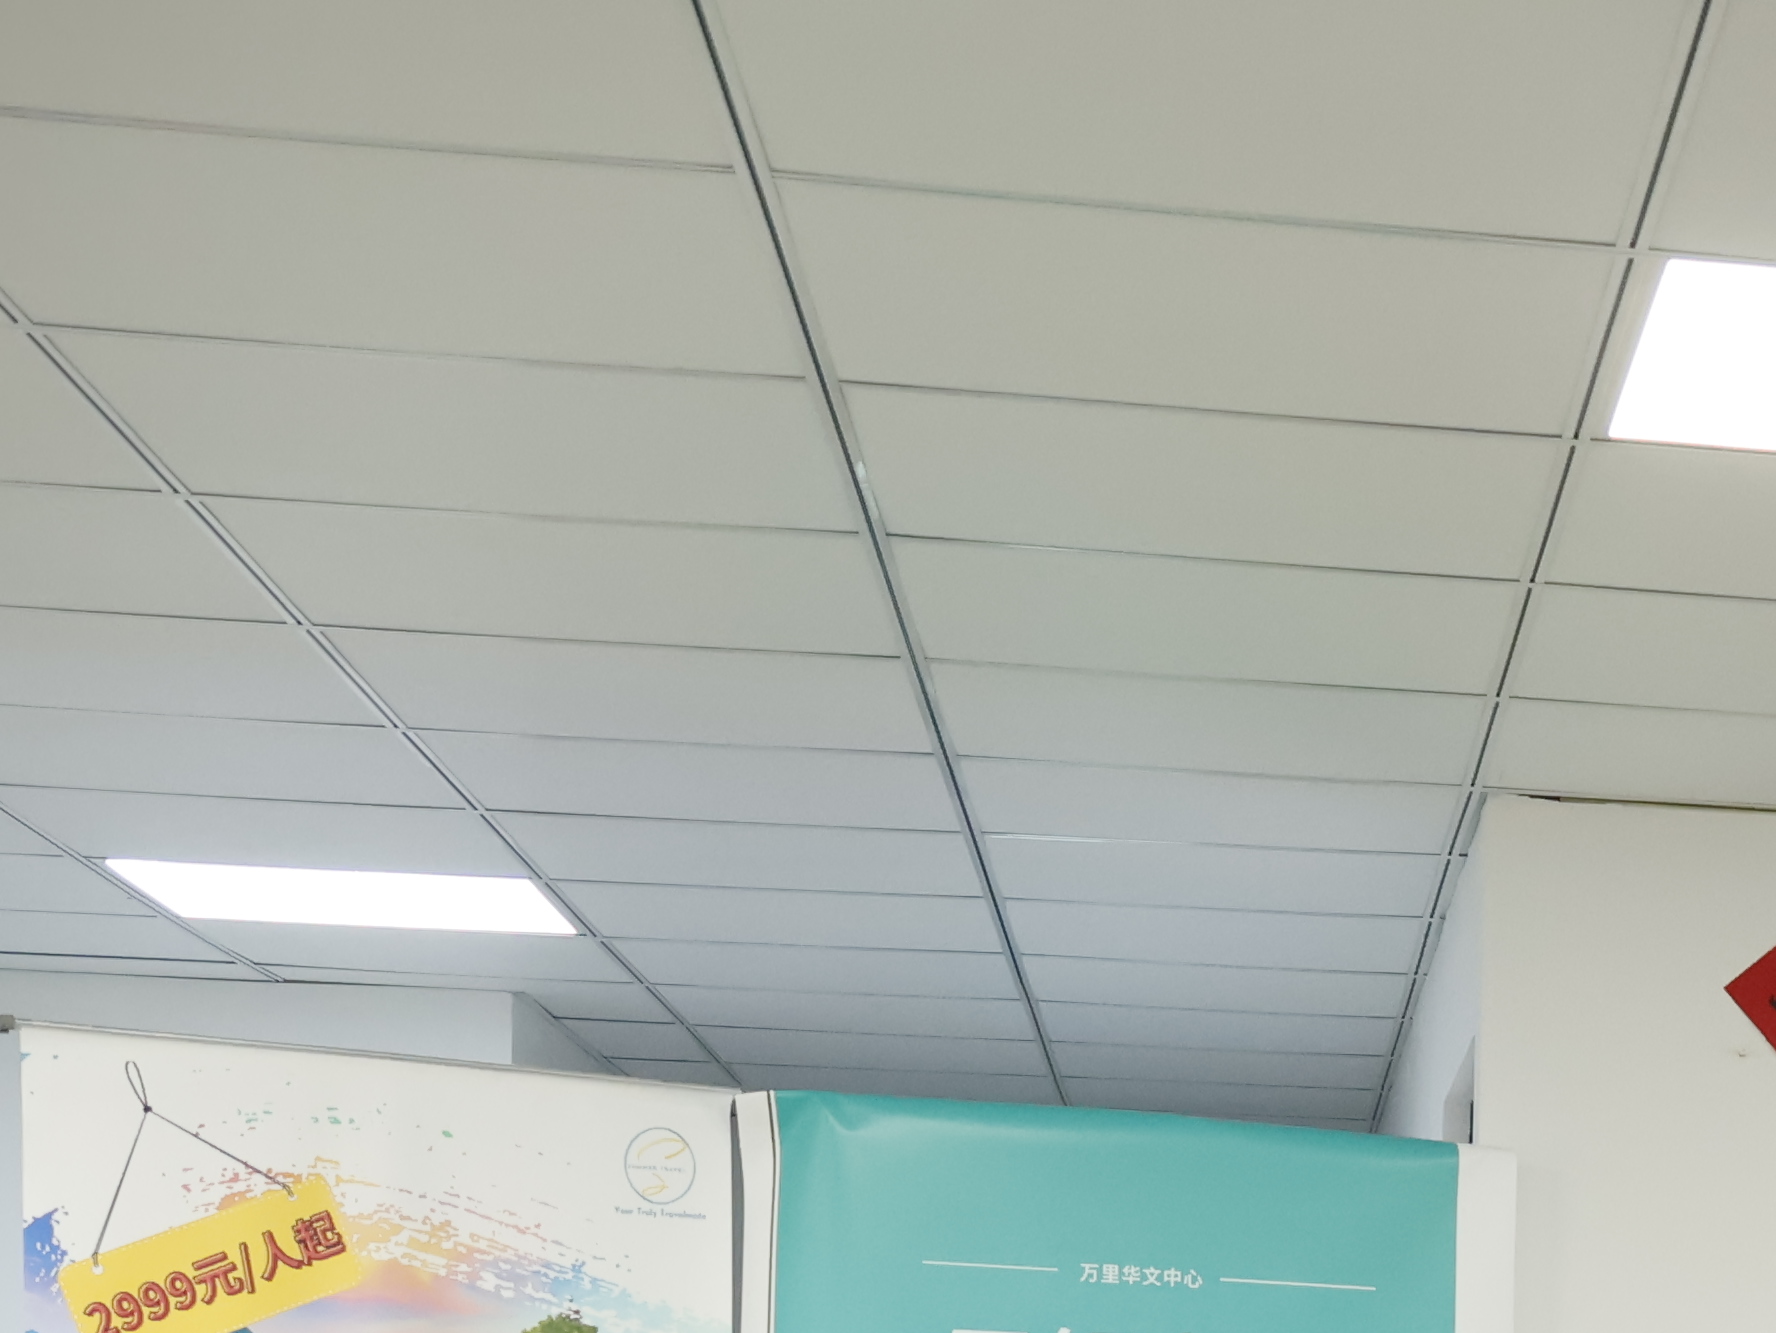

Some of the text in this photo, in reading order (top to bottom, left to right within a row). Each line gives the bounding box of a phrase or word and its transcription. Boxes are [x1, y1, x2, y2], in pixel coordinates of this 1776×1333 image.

[1079, 1262, 1204, 1290] 万里华文中心
